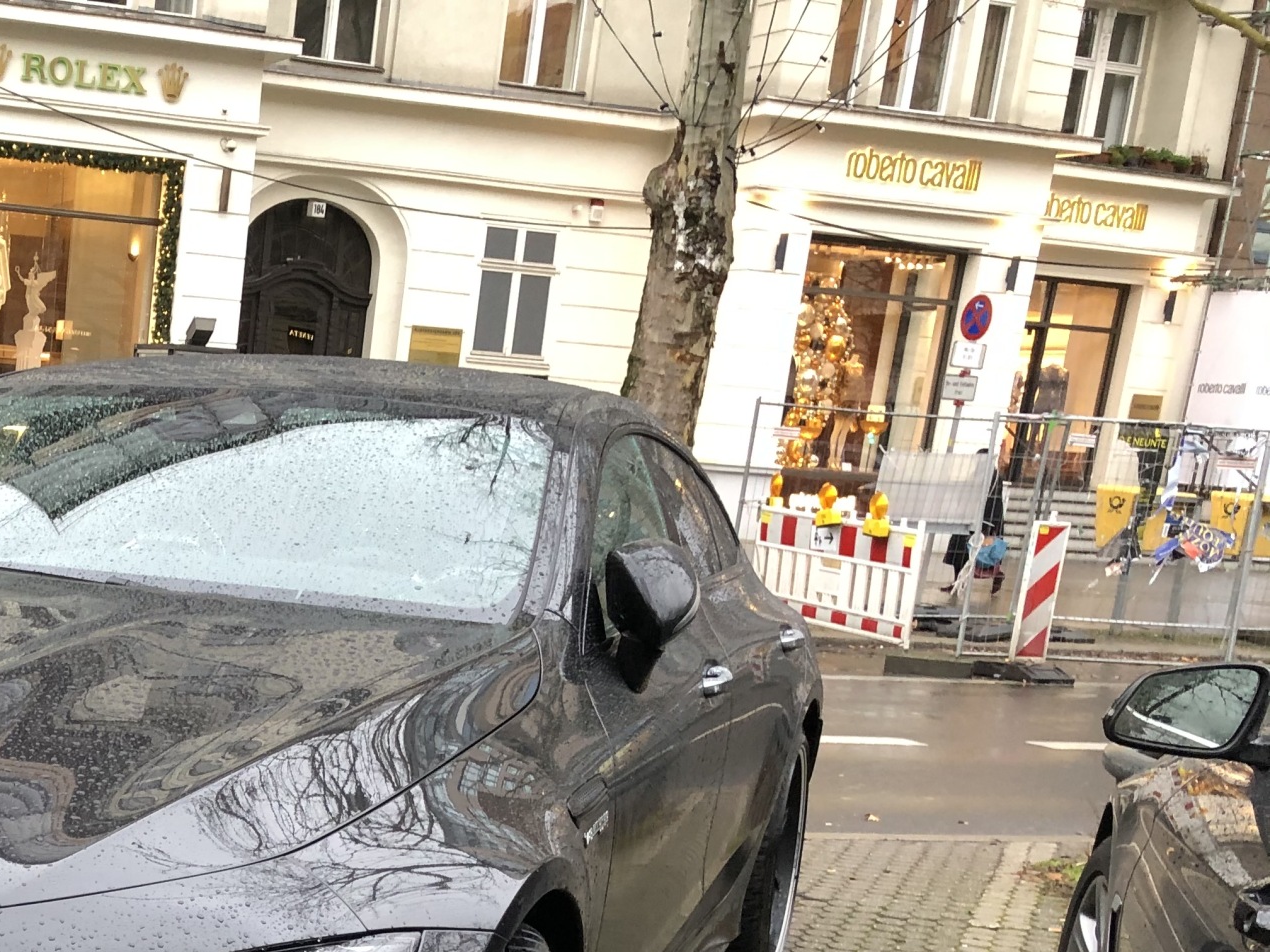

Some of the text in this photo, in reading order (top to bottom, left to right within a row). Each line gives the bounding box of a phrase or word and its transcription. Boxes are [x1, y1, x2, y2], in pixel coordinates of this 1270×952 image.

[21, 53, 147, 96] ROLEX
[846, 148, 982, 191] roberto cavalli
[314, 203, 324, 214] 184
[1094, 203, 1149, 231] cavalli
[1197, 382, 1222, 394] roberto
